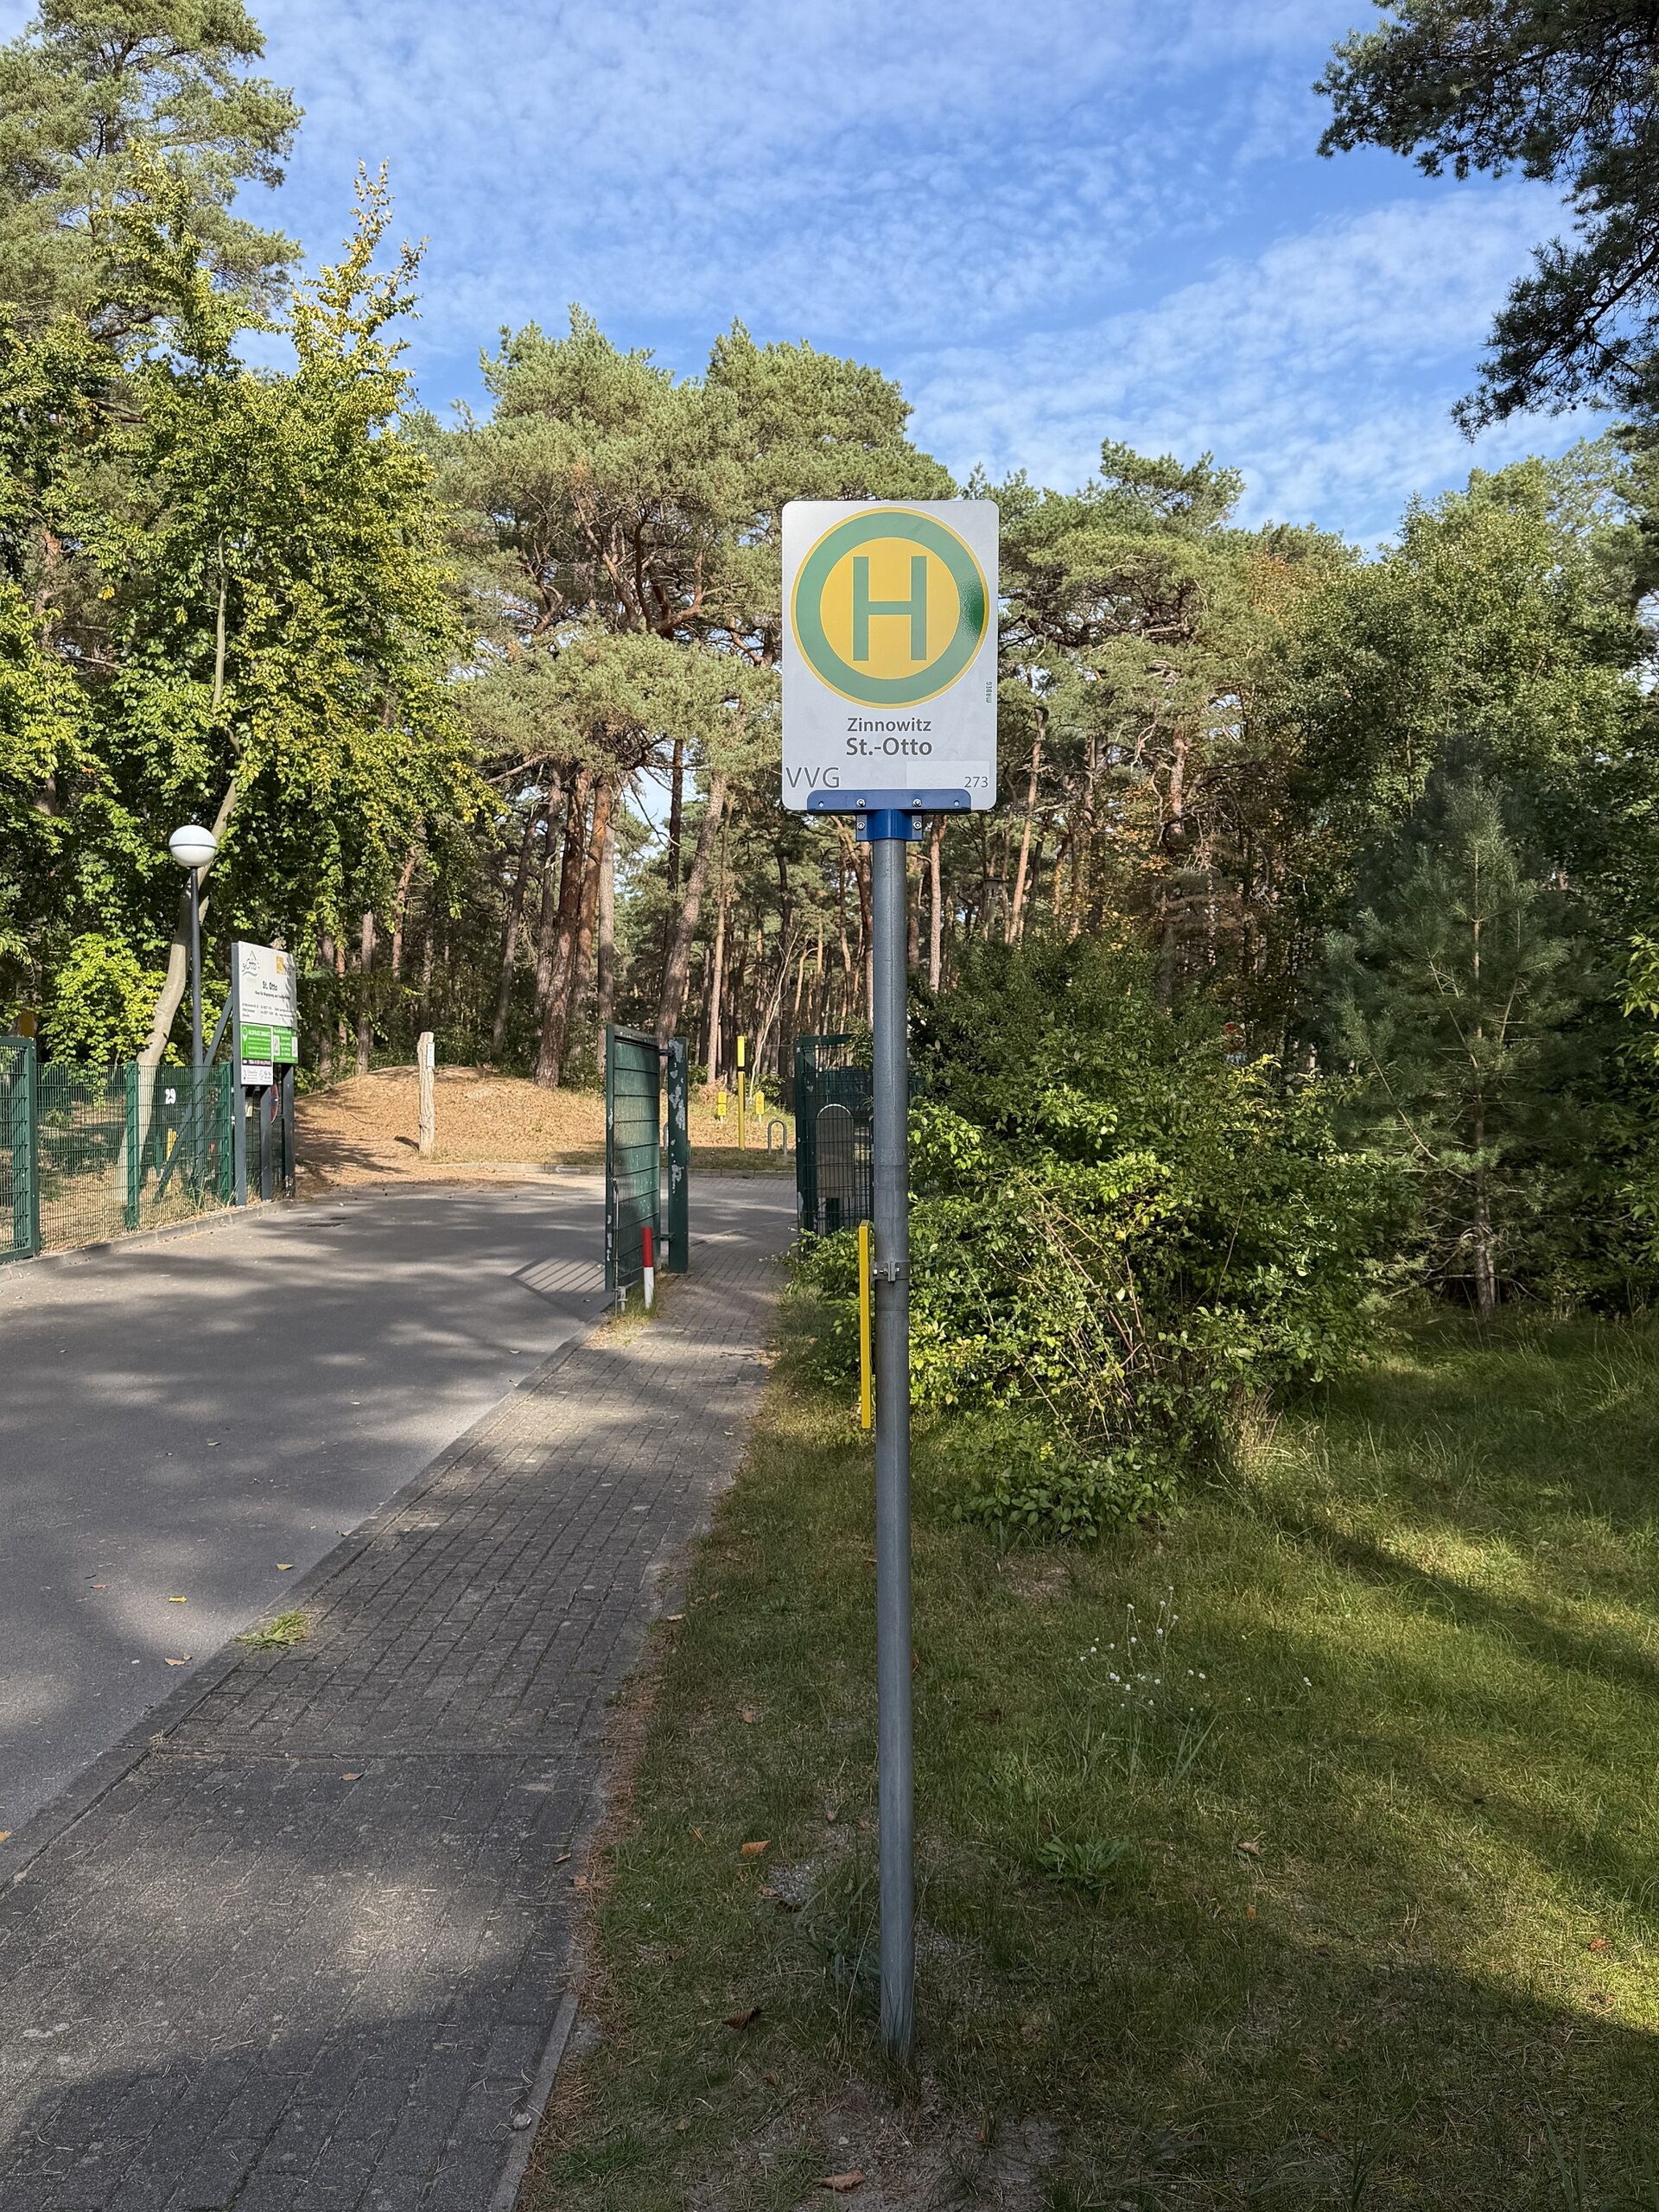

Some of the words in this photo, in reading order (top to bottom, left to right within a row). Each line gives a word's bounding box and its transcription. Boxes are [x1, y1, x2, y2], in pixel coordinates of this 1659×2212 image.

[853, 556, 927, 662] H
[847, 717, 931, 732] Zinnowitz
[846, 737, 932, 756] St.-Otto
[785, 766, 840, 788] VVG
[964, 776, 988, 788] 273
